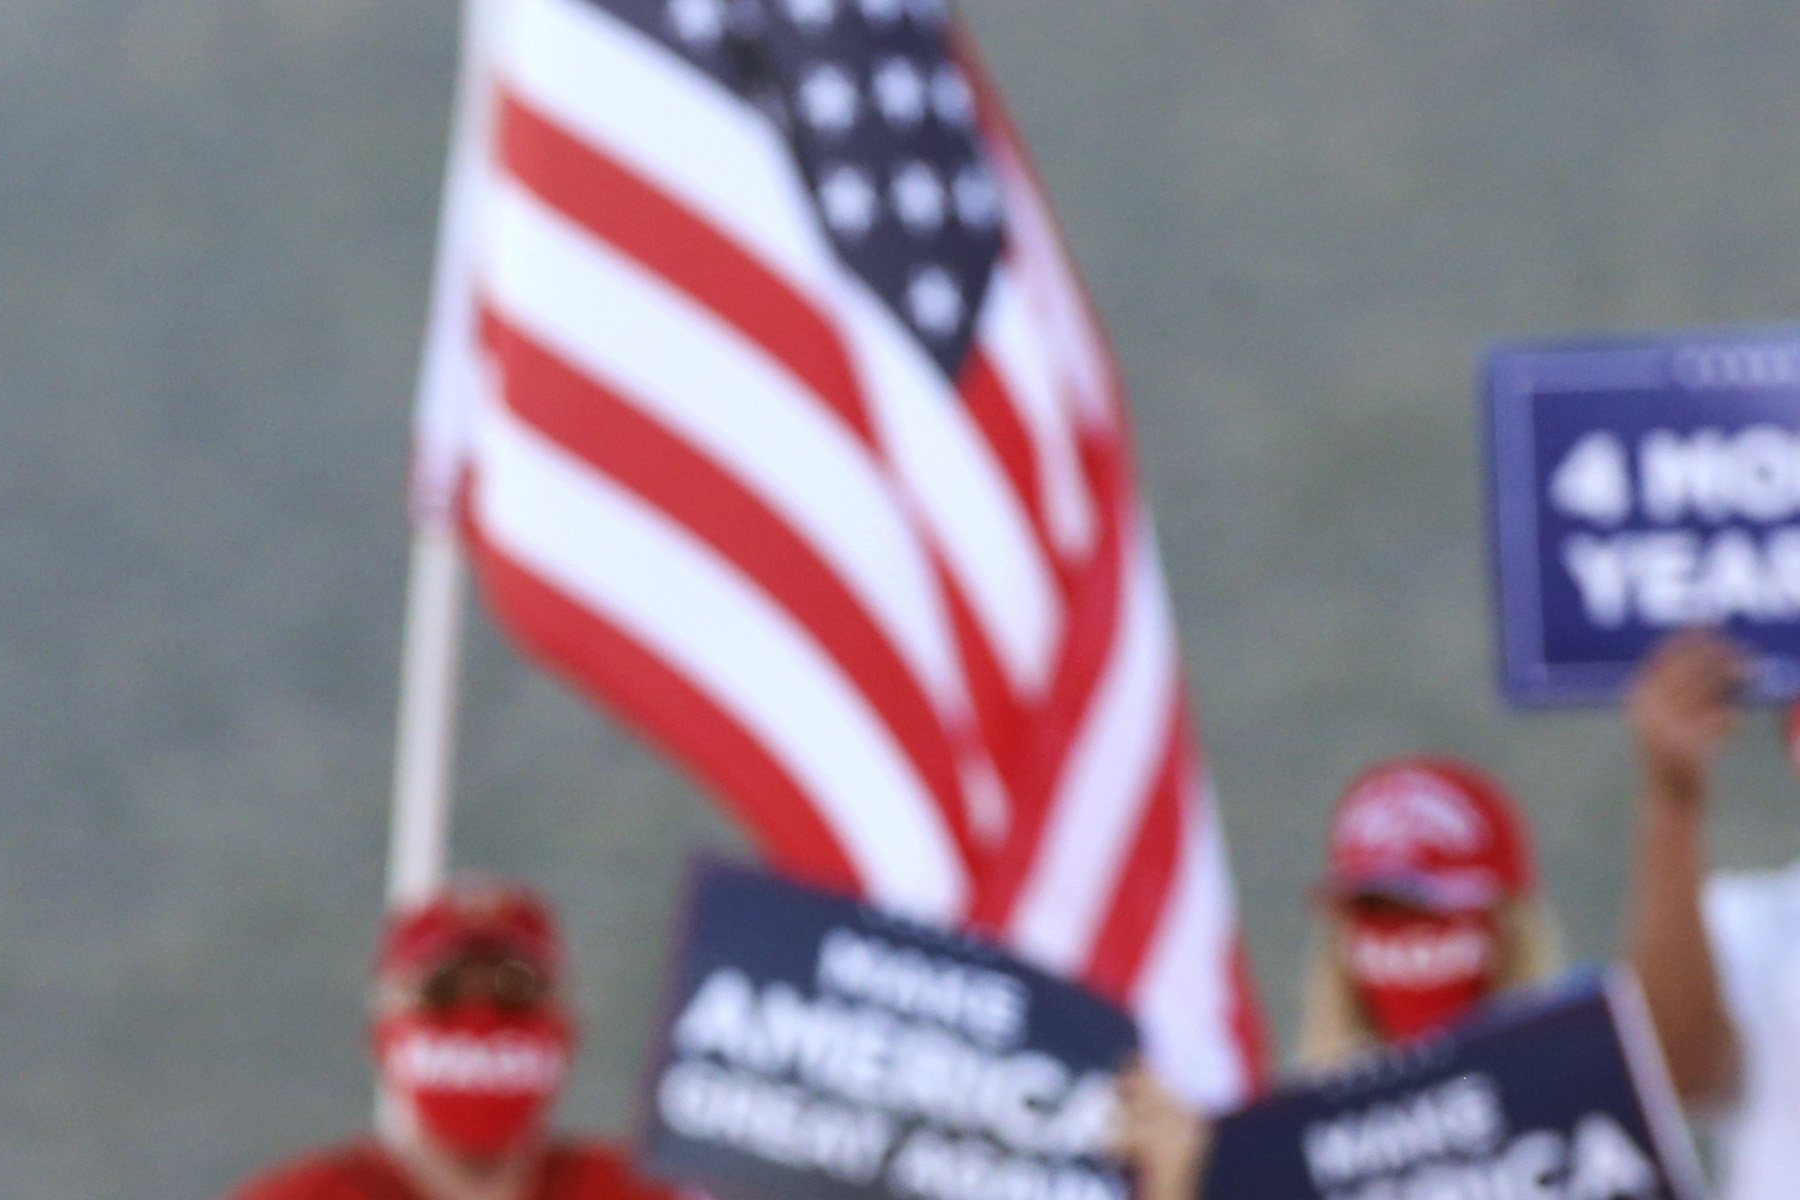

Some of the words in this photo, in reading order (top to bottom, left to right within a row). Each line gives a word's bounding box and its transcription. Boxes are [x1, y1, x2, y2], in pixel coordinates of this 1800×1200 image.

[1547, 428, 1632, 526] 4
[1636, 424, 1800, 524] MO
[817, 926, 1032, 1050] MAKE
[674, 966, 1130, 1160] AMERICA
[1302, 1072, 1500, 1190] MAKE
